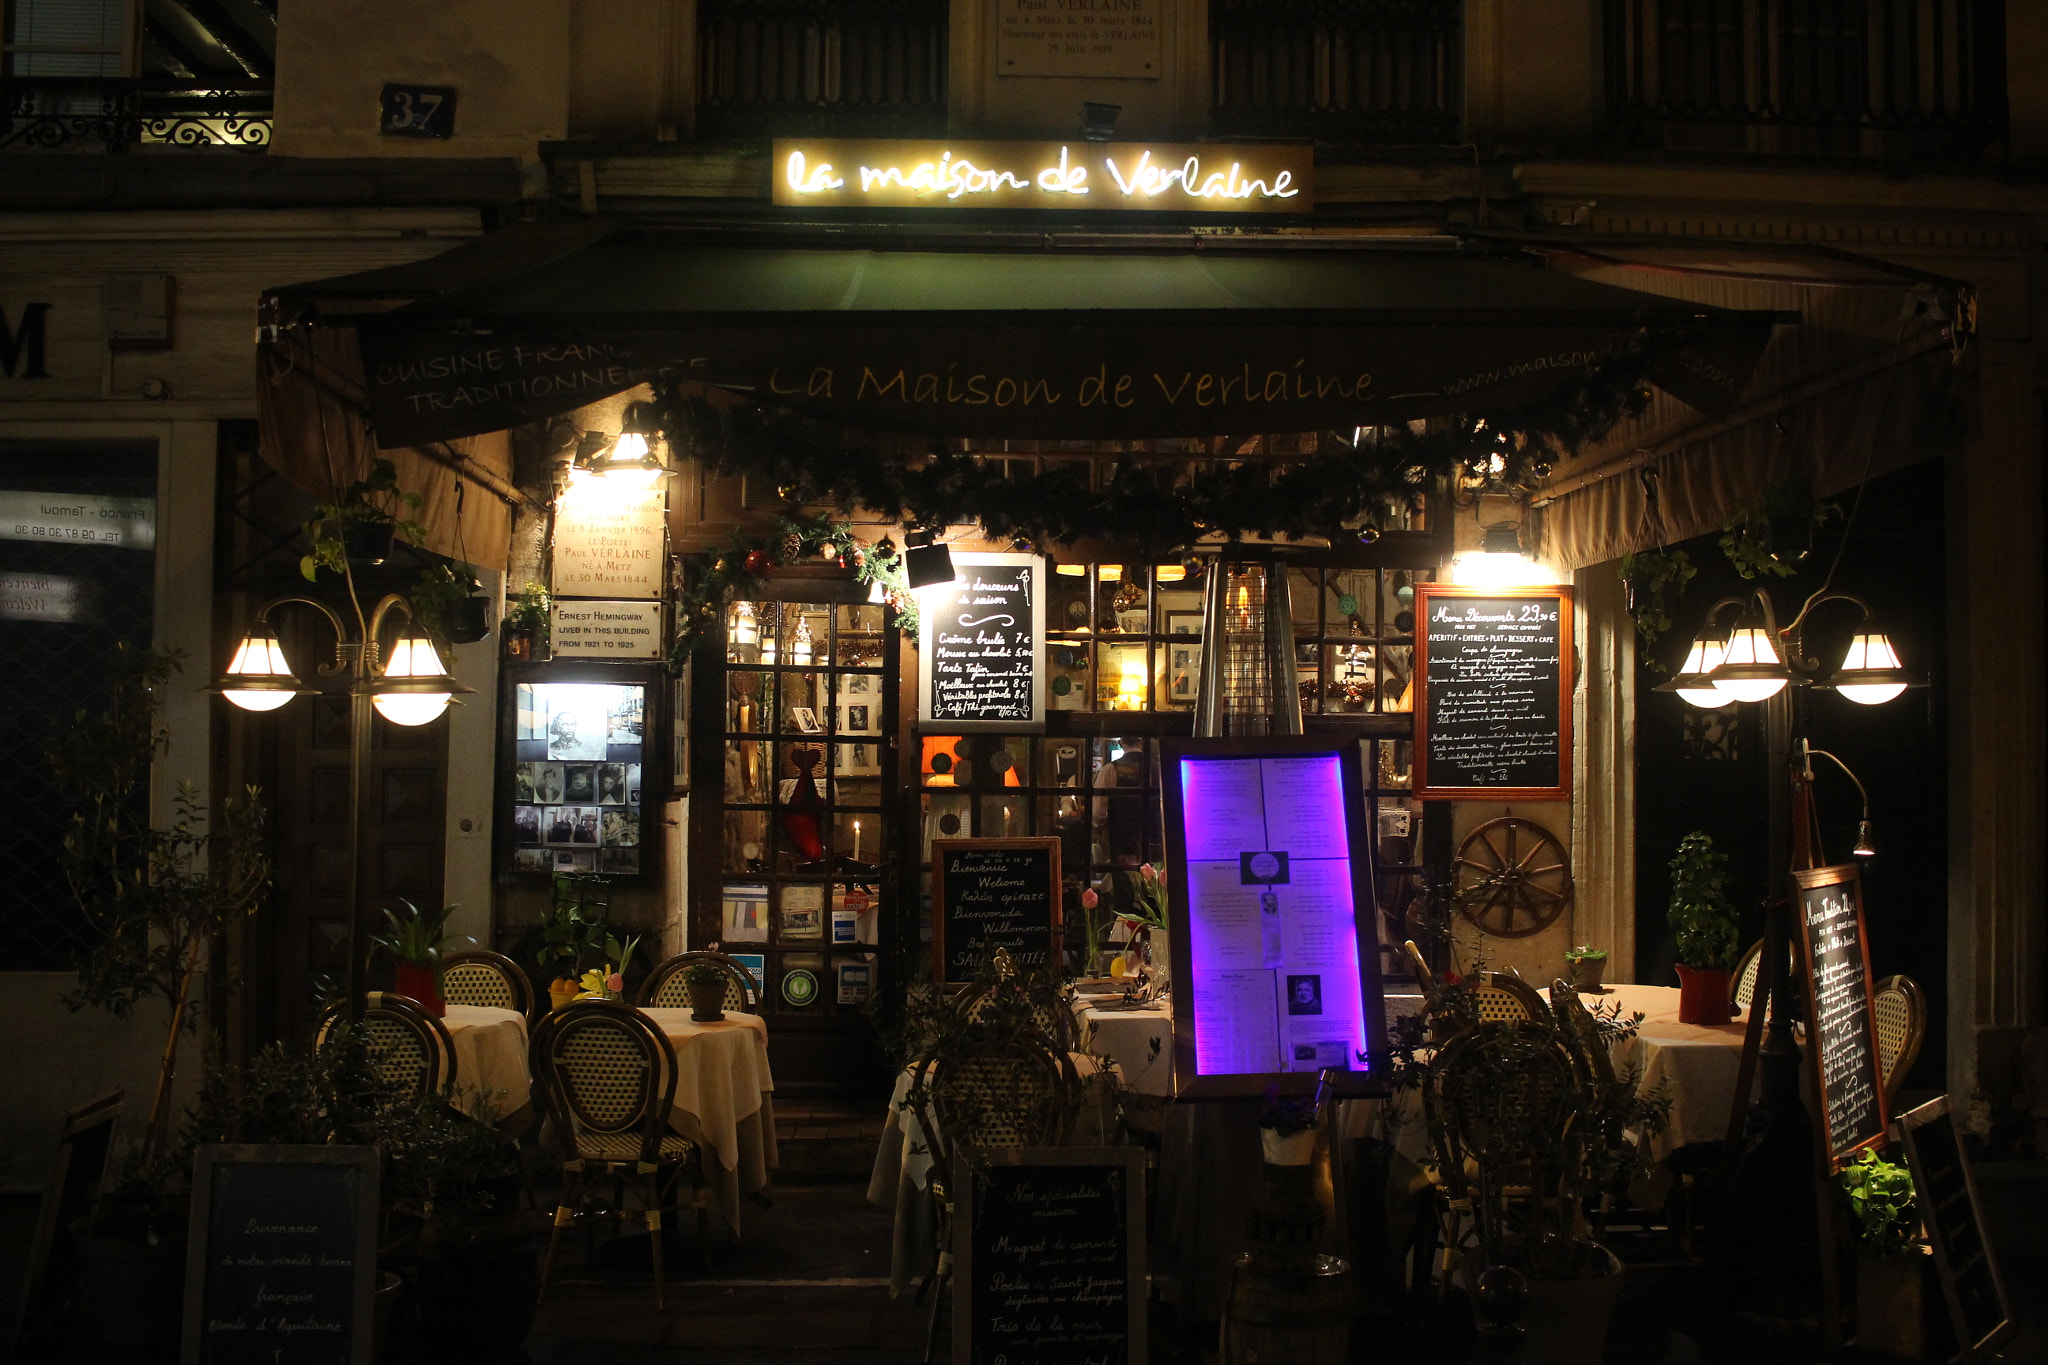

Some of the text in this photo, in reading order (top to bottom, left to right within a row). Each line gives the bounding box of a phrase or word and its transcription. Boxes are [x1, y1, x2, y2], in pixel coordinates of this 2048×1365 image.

[1100, 17, 1125, 26] mars
[1131, 15, 1153, 26] 1844
[1103, 30, 1155, 41] VERLAINE
[392, 92, 443, 129] 37
[787, 150, 843, 194] la
[861, 150, 1029, 199] maison
[1036, 145, 1090, 194] de
[376, 349, 503, 386] CUISINE
[770, 359, 1376, 408] La Maison de Verlaine
[591, 547, 652, 560] VERLAINE
[578, 573, 591, 582] 30
[972, 576, 1020, 592] douceurs
[973, 594, 1008, 605] saison
[1432, 606, 1464, 623] Menu
[1464, 607, 1516, 622] Découverte
[594, 627, 612, 635] THIS
[614, 627, 650, 635] BUILDING
[559, 640, 581, 648] FROM
[617, 641, 635, 649] 1925
[937, 661, 963, 673] Tarte
[965, 662, 990, 673] Tatin
[950, 859, 1009, 873] Bienvenue
[978, 876, 1026, 888] Welcome
[951, 905, 1024, 919] Bienvenida
[982, 921, 1049, 934] Willkommen
[1006, 1181, 1035, 1202] Nos
[243, 1217, 319, 1234] Provenance
[991, 1235, 1047, 1263] Magret
[1070, 1235, 1118, 1250] canard
[221, 1254, 233, 1266] de
[237, 1253, 265, 1266] notre
[270, 1254, 313, 1266] viande
[1049, 1276, 1083, 1290] Saint
[1084, 1274, 1125, 1295] Jacques
[255, 1283, 314, 1309] française
[1071, 1290, 1124, 1307] champagne
[208, 1317, 247, 1333] Blonde
[989, 1314, 1103, 1333] Trio de la mer
